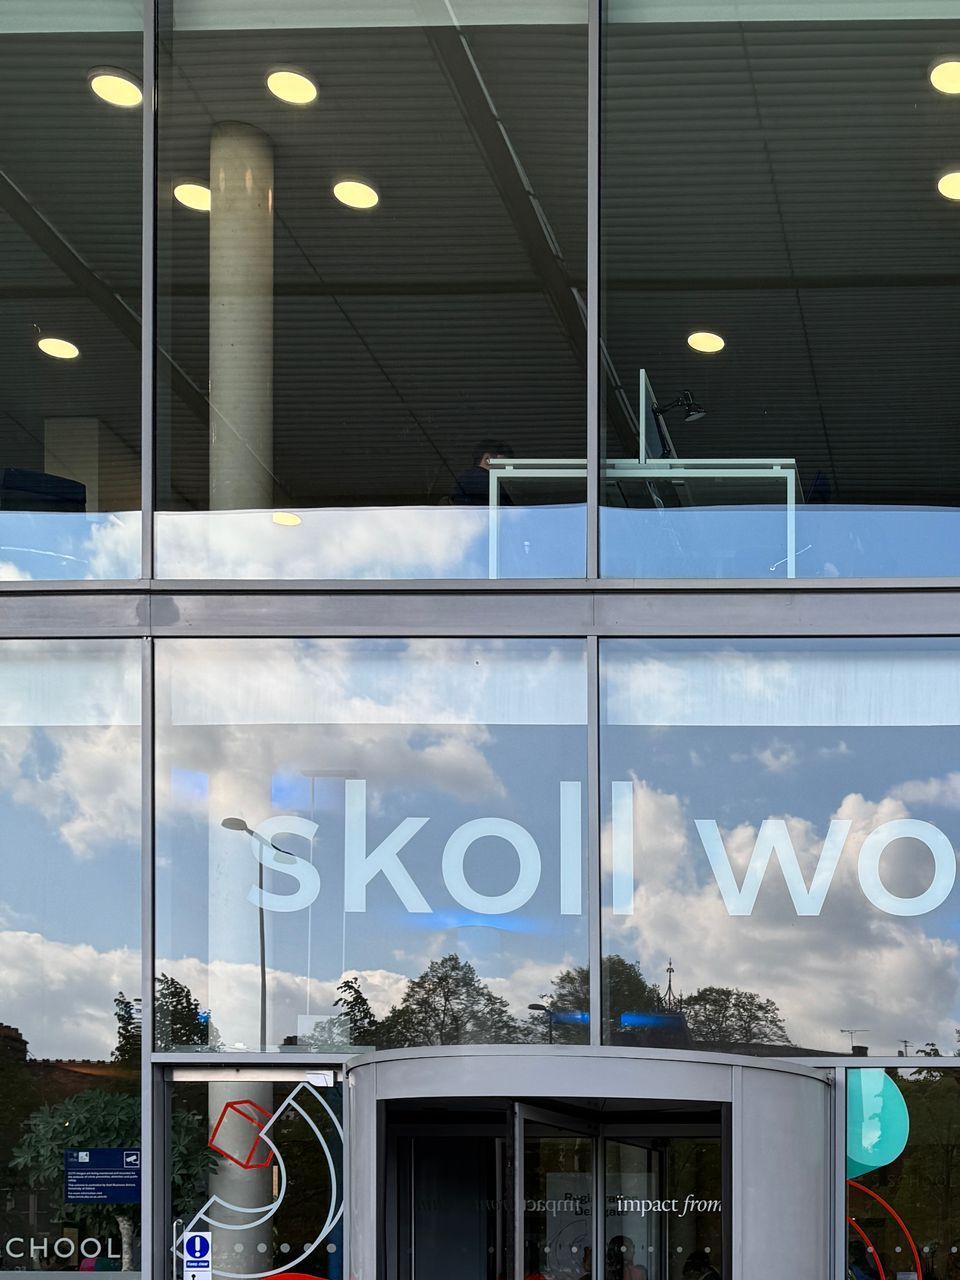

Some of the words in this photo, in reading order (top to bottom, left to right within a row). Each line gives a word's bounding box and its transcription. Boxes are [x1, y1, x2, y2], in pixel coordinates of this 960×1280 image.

[246, 779, 634, 915] skoll
[678, 1194, 722, 1217] from
[0, 1237, 121, 1259] CHOOL
